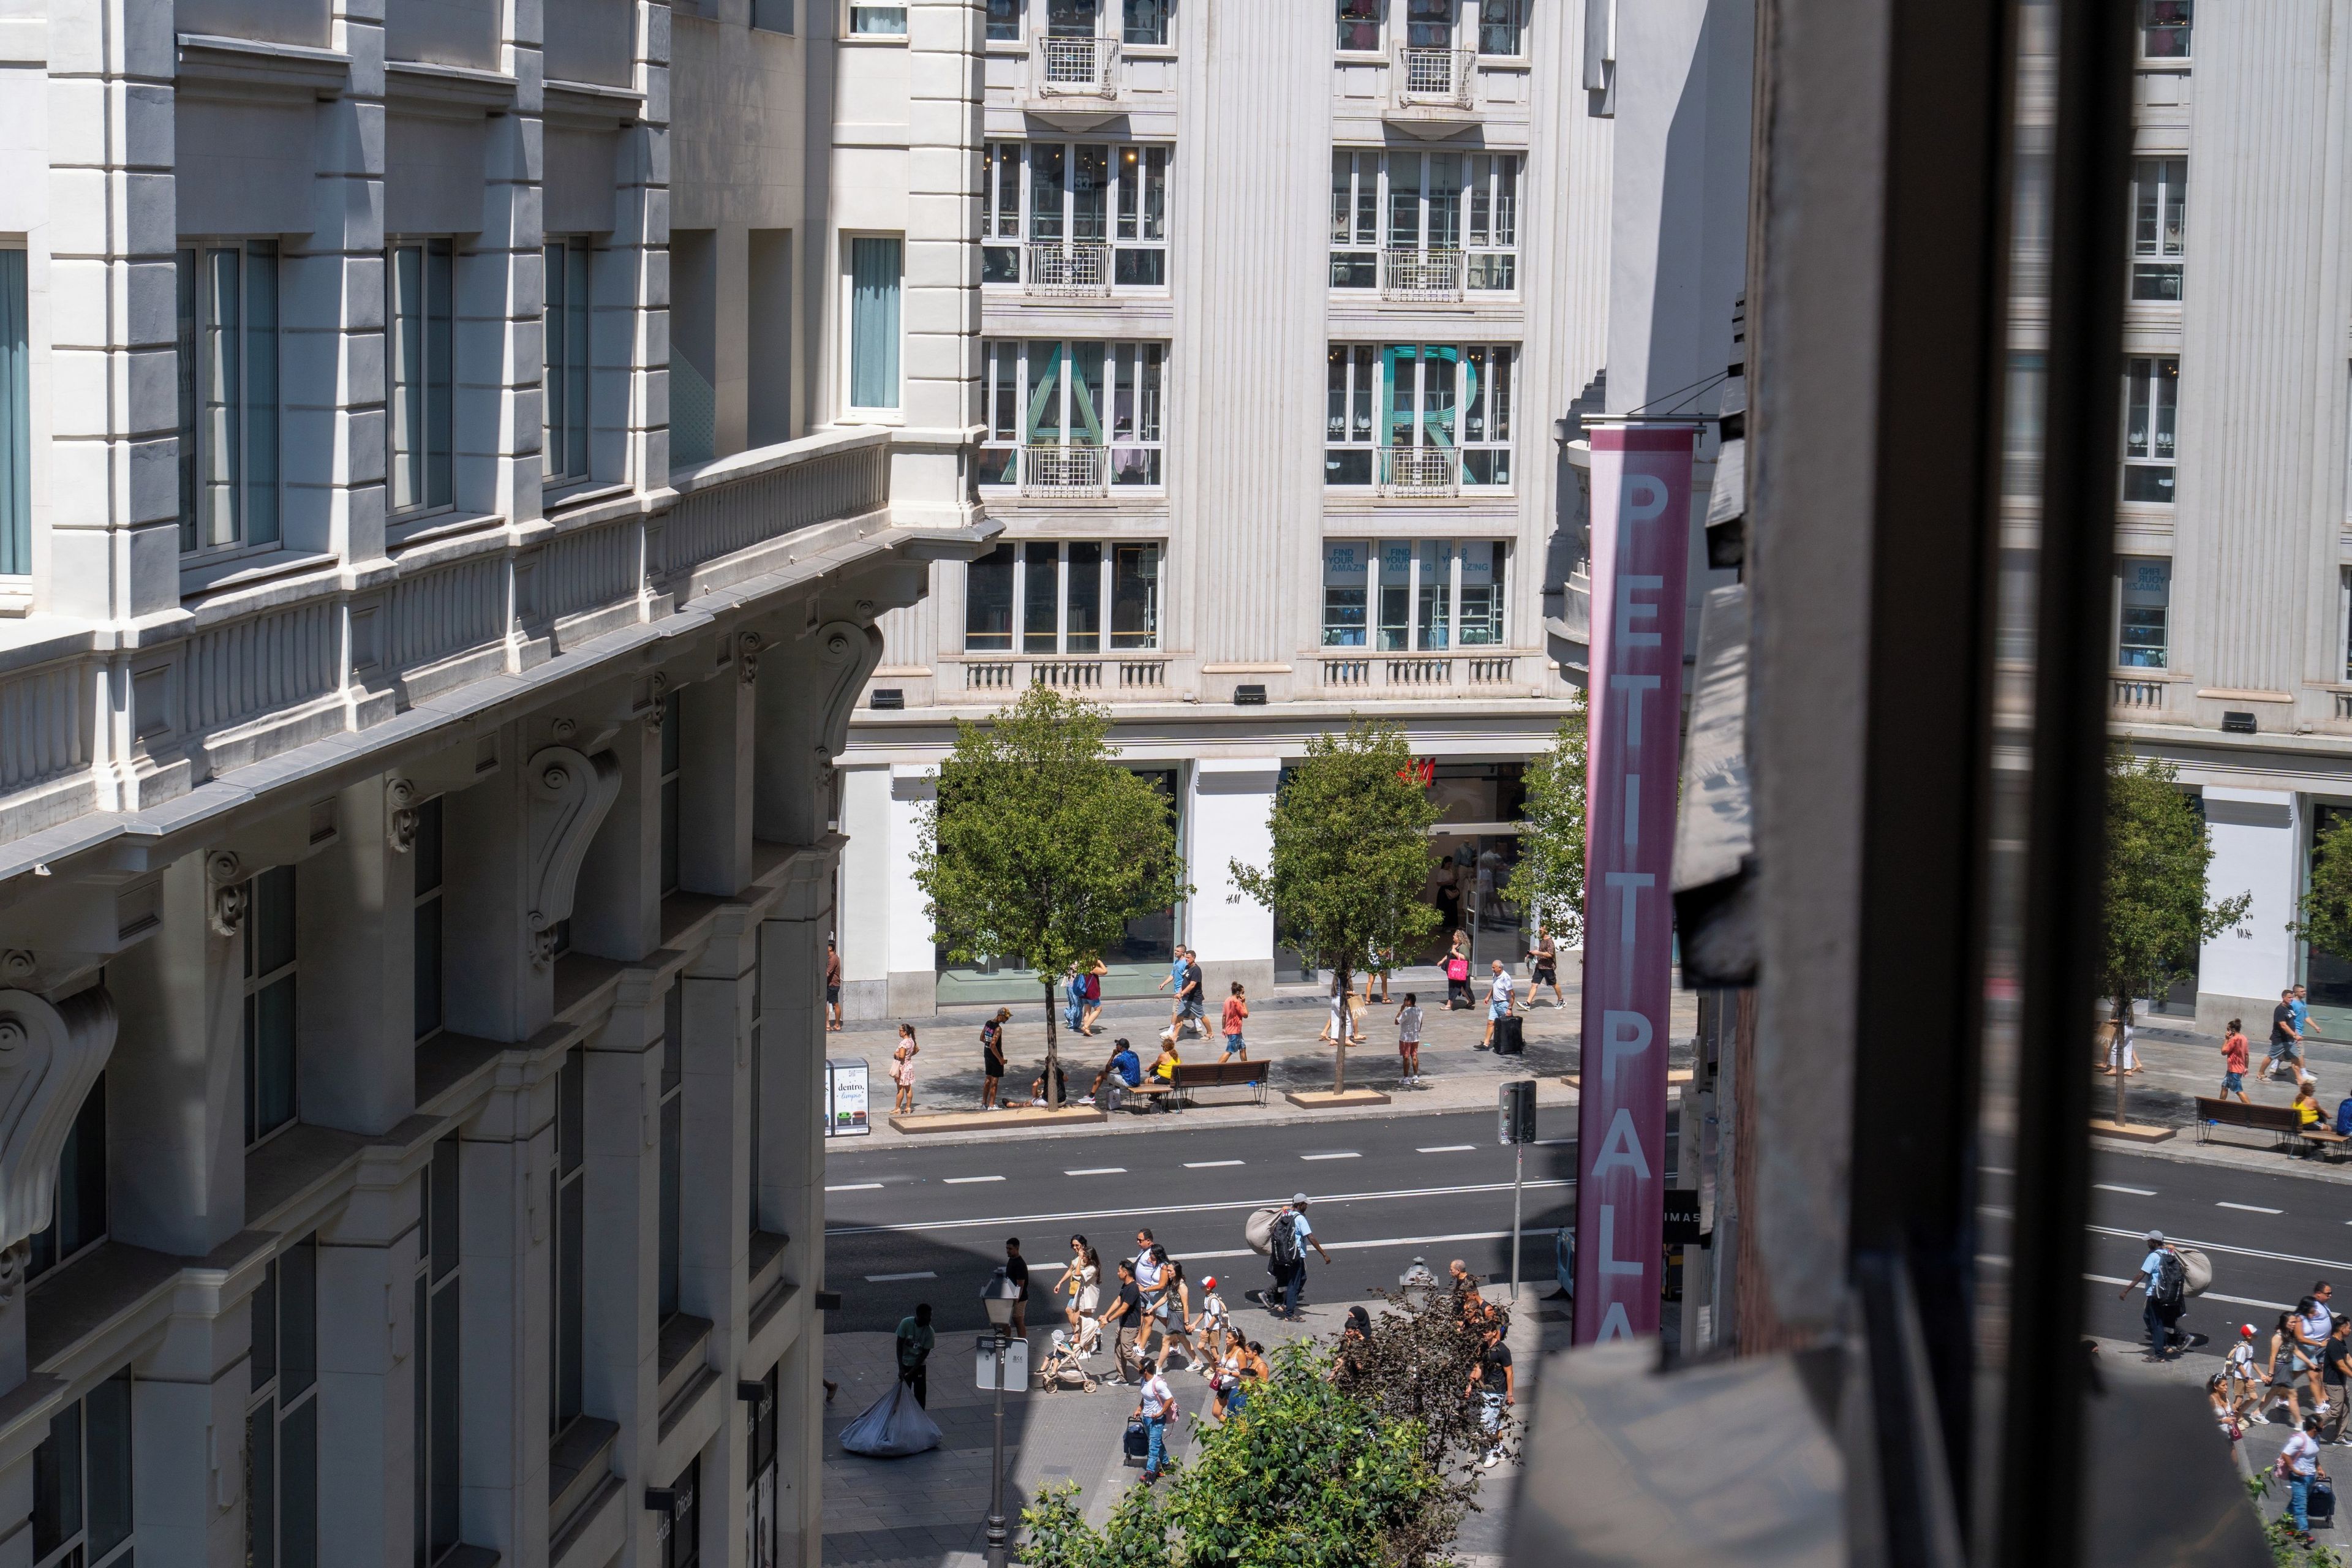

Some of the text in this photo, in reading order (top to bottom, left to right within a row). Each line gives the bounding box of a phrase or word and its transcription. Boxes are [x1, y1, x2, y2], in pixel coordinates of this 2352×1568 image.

[1447, 548, 1468, 556] FD
[1604, 474, 1669, 942] PETIT
[676, 1484, 693, 1521] Oficial
